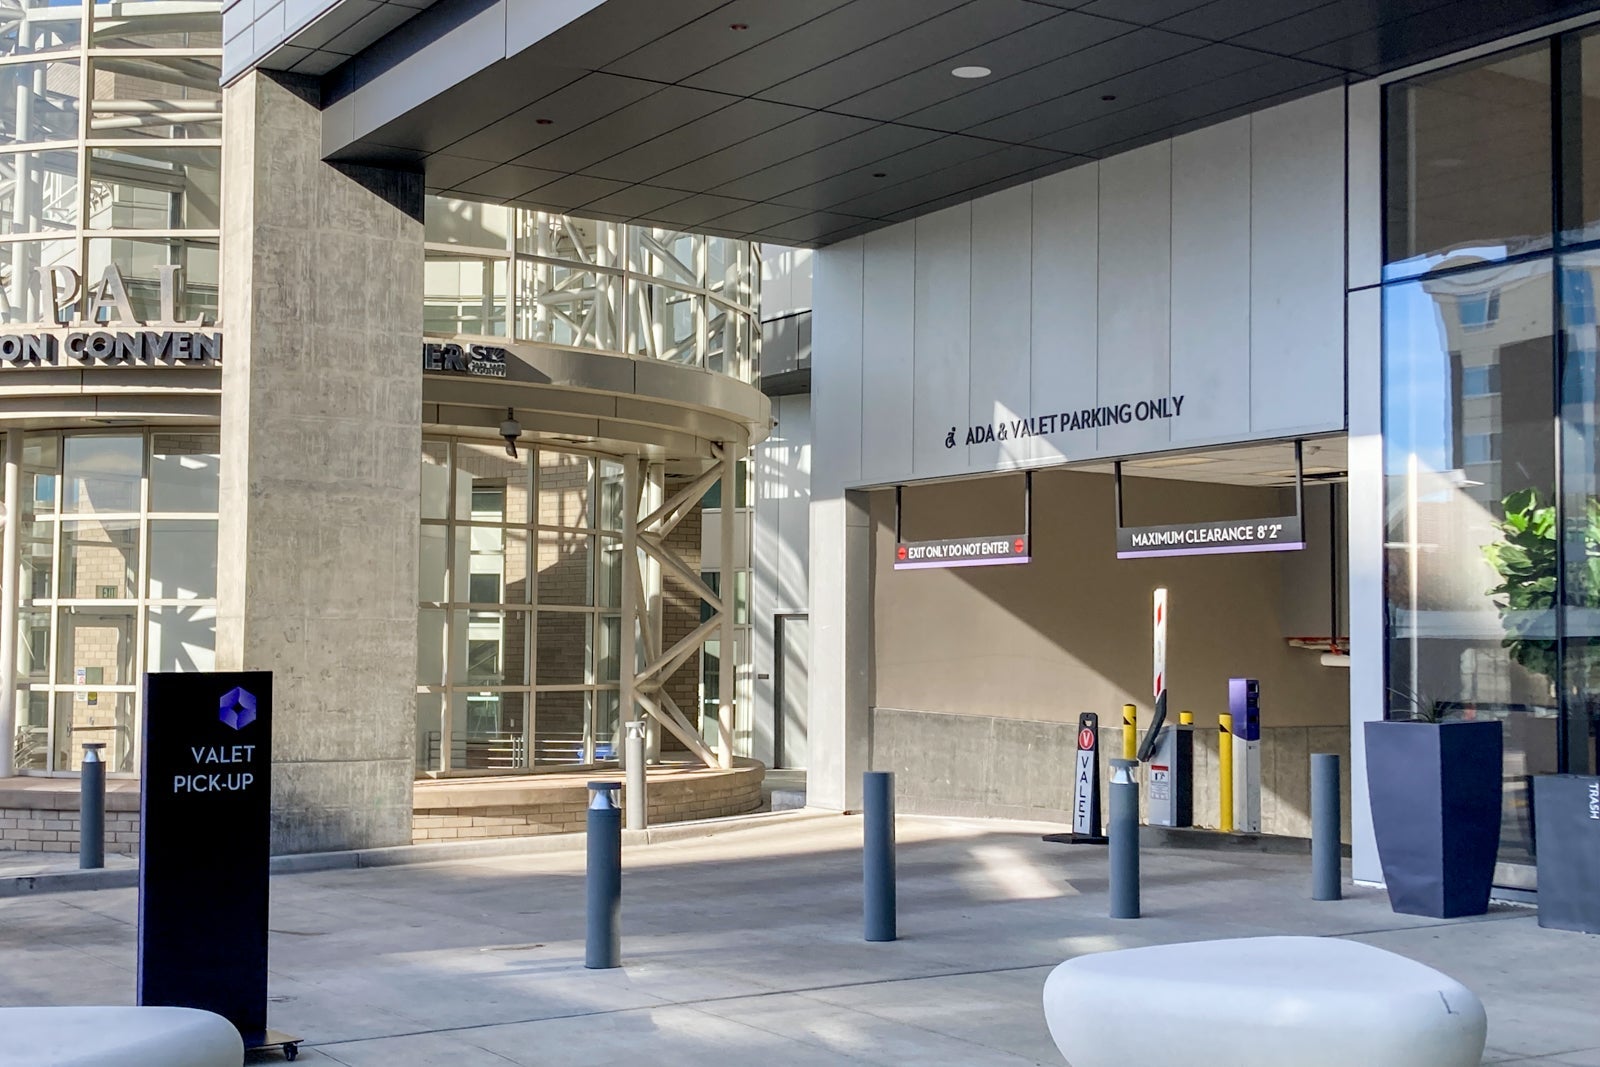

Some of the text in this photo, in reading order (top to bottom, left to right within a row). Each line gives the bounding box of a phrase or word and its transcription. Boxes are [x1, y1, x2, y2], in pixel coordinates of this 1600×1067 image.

[34, 262, 223, 328] PAL
[966, 395, 1185, 446] ADA & VALET PARKING ONLY
[1132, 530, 1185, 547] MAXIMUM
[1185, 525, 1254, 544] CLEARANCE
[908, 541, 1009, 559] EXIT ONLY DO NOT ENTER
[1082, 732, 1091, 747] V
[191, 745, 256, 764] VALET
[173, 773, 254, 793] PICK-UP
[1078, 756, 1089, 828] VALET
[1589, 783, 1599, 819] TRASH
